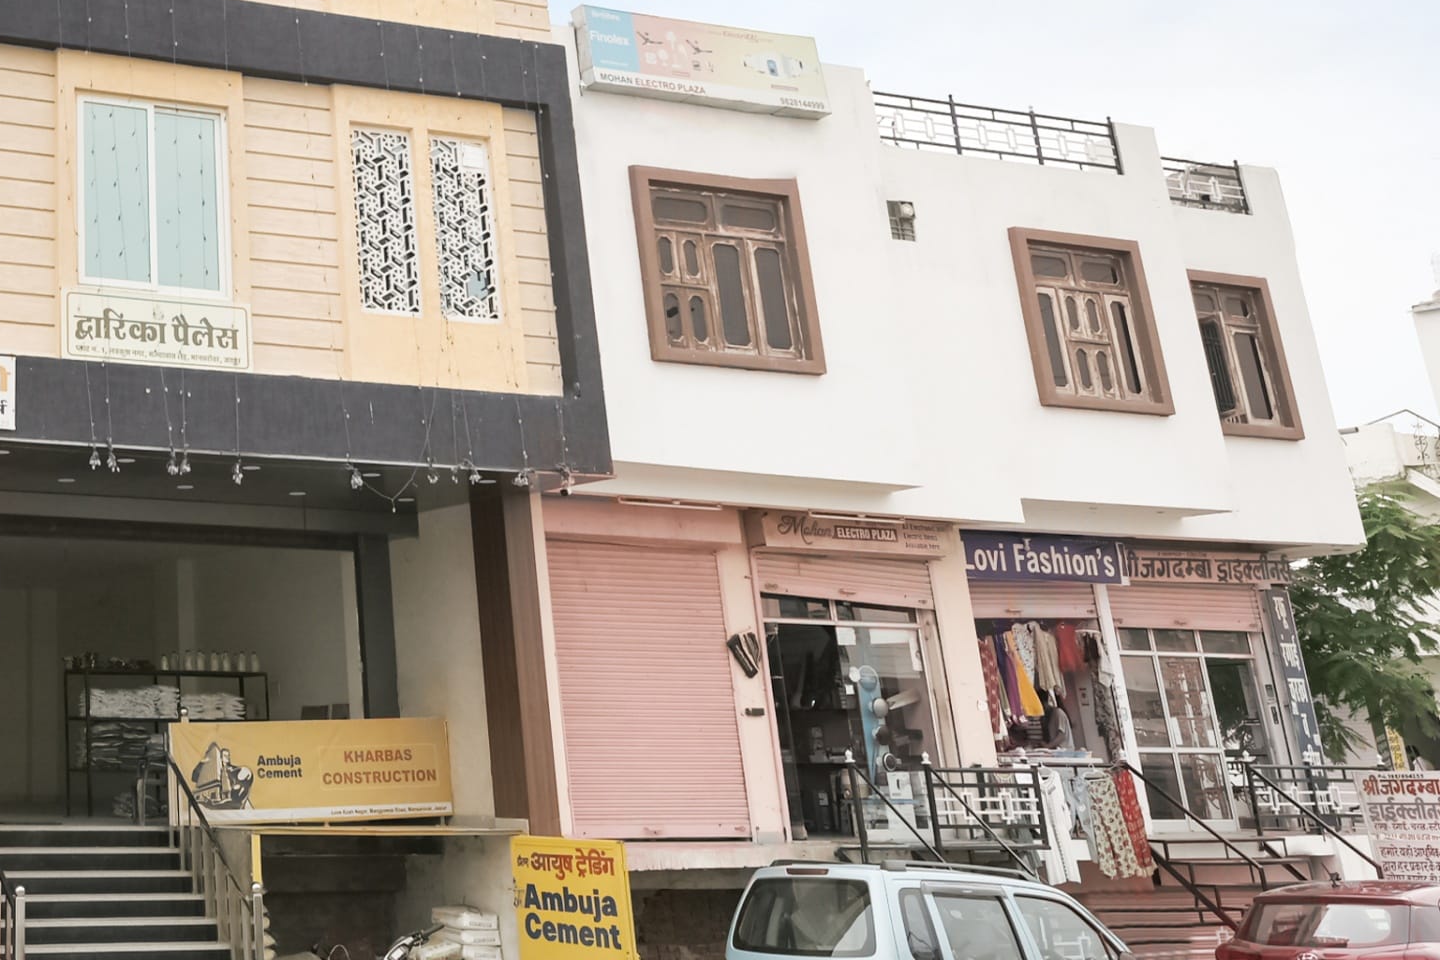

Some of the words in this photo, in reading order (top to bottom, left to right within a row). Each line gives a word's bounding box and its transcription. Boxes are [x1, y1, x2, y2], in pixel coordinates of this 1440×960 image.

[599, 73, 633, 84] MOHAN
[634, 78, 676, 90] ELECTRO
[677, 83, 707, 94] PLAZA
[74, 308, 167, 344] द्वारिका
[172, 314, 239, 350] पैलेस
[837, 527, 871, 540] ELECTRO
[872, 529, 897, 541] PLAZA
[1013, 543, 1115, 577] Fashion's
[257, 755, 302, 768] Ambuja
[343, 749, 413, 764] KHARBAS
[257, 768, 303, 779] Cement
[322, 769, 437, 785] CONSTRUCTION
[531, 852, 573, 881] आयुष
[575, 848, 615, 878] ट्रेडिंग
[524, 883, 618, 923] Ambuja
[525, 912, 622, 950] Cement
